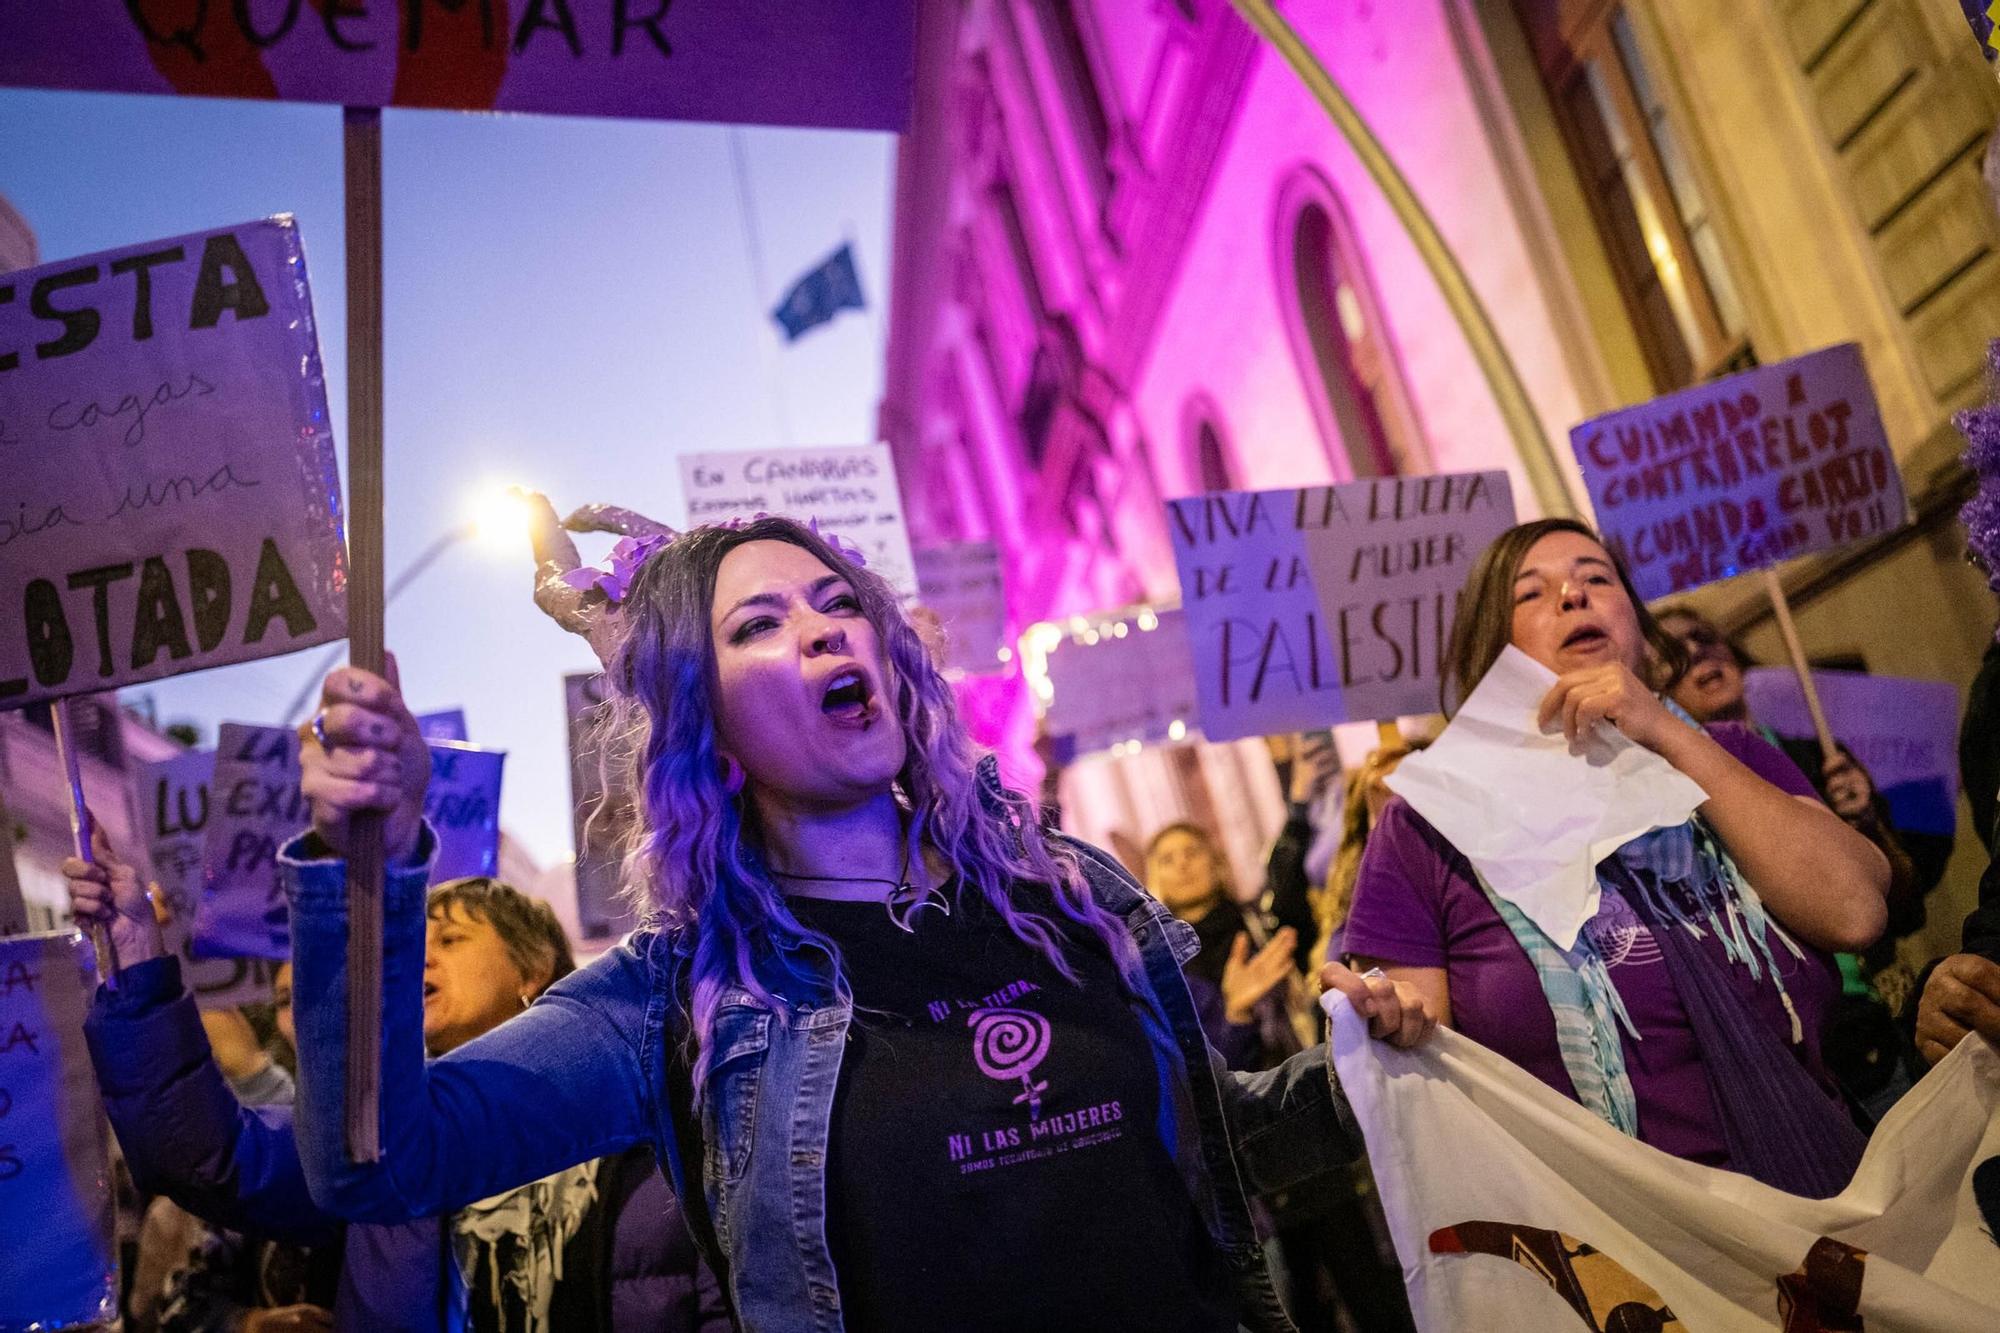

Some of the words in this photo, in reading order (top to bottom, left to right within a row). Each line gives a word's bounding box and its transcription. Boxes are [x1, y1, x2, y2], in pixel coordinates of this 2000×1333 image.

[0, 232, 270, 372] STA
[1167, 491, 1277, 547] VIVA
[1295, 484, 1350, 533] LA
[0, 536, 318, 696] OTADA
[948, 1133, 973, 1161] NI
[983, 1127, 1021, 1152] LAS
[1029, 1100, 1125, 1141] MUJERES
